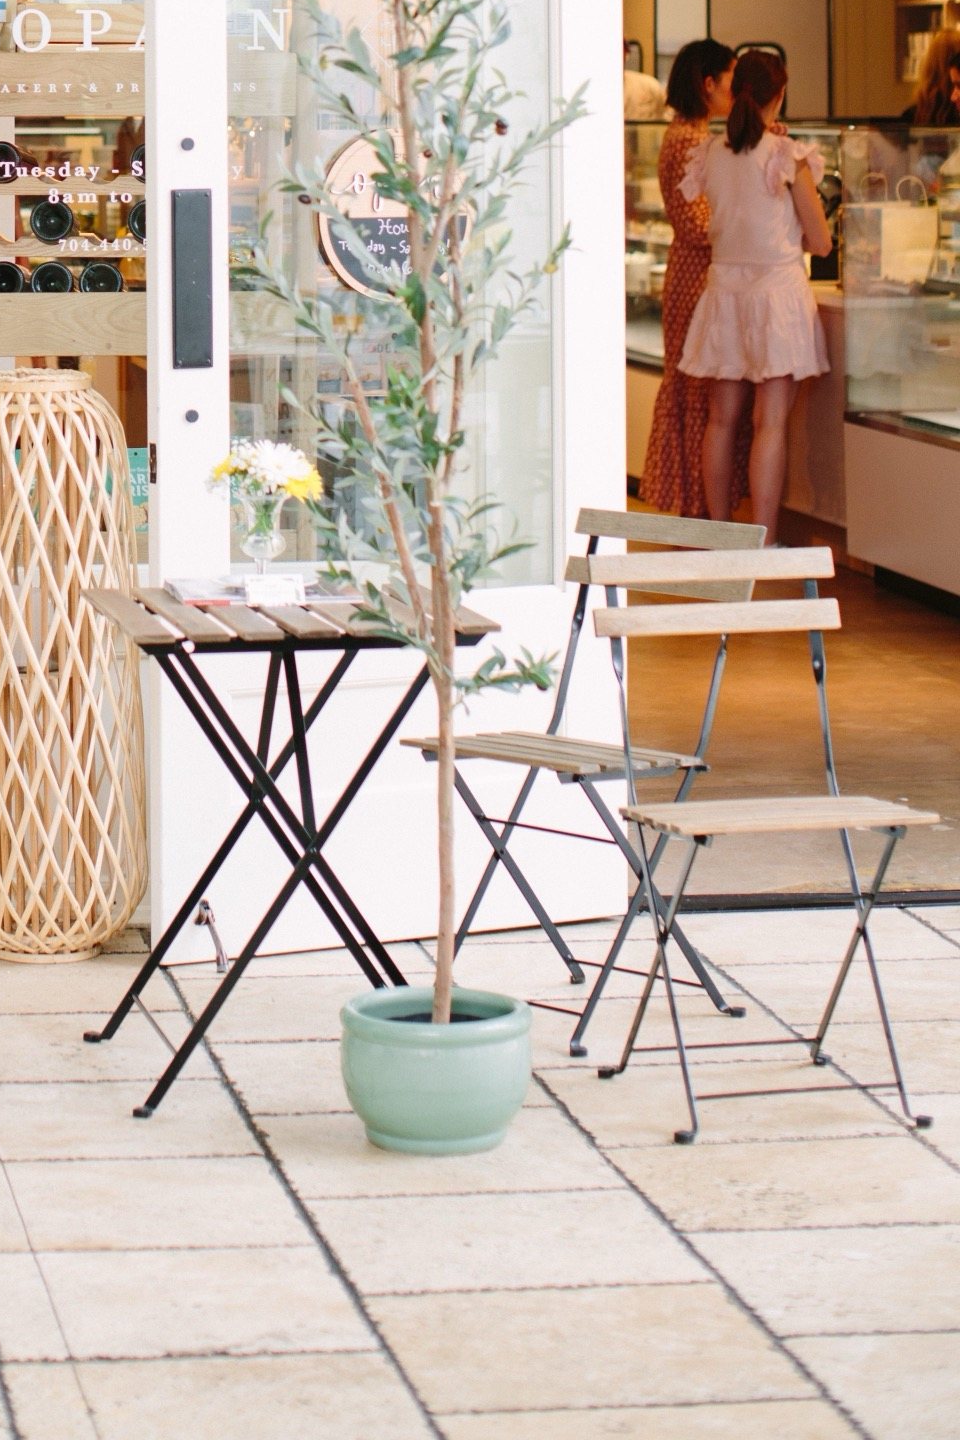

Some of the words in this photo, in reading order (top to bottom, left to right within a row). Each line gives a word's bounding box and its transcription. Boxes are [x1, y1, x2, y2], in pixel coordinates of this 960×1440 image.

[89, 83, 99, 94] &
[0, 161, 101, 181] Tuesday
[48, 188, 99, 204] 8am
[110, 190, 133, 204] to
[377, 218, 411, 236] Hou
[58, 238, 148, 252] 704.440.5
